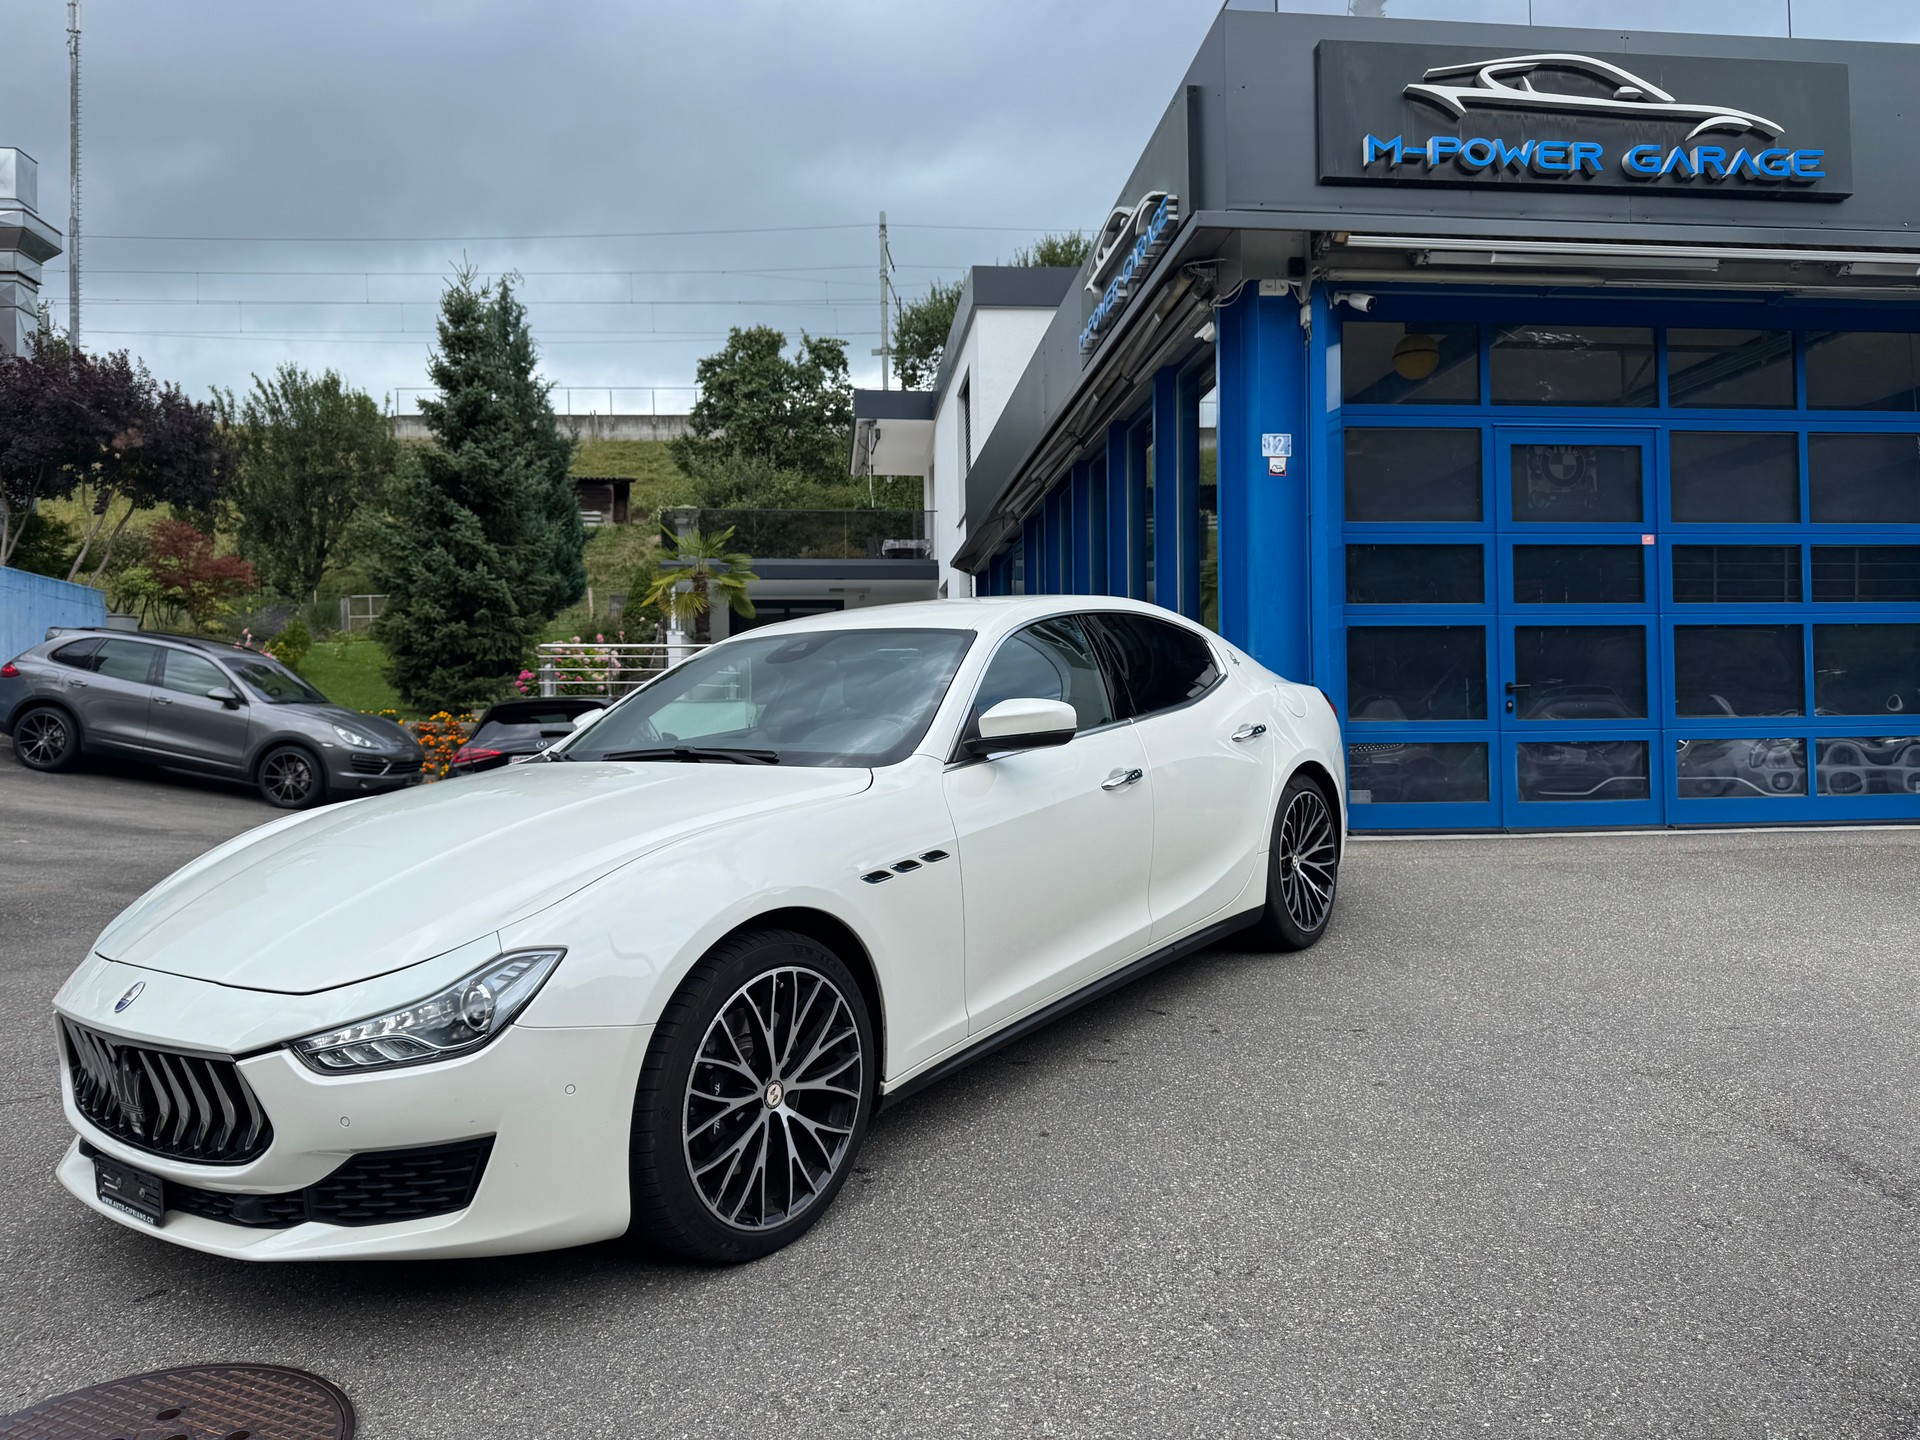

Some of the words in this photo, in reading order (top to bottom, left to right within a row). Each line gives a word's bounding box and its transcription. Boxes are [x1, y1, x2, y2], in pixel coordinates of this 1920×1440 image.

[1362, 133, 1604, 173] M-POWER
[1624, 143, 1826, 178] GARAGE
[1122, 194, 1170, 285] GARAGE
